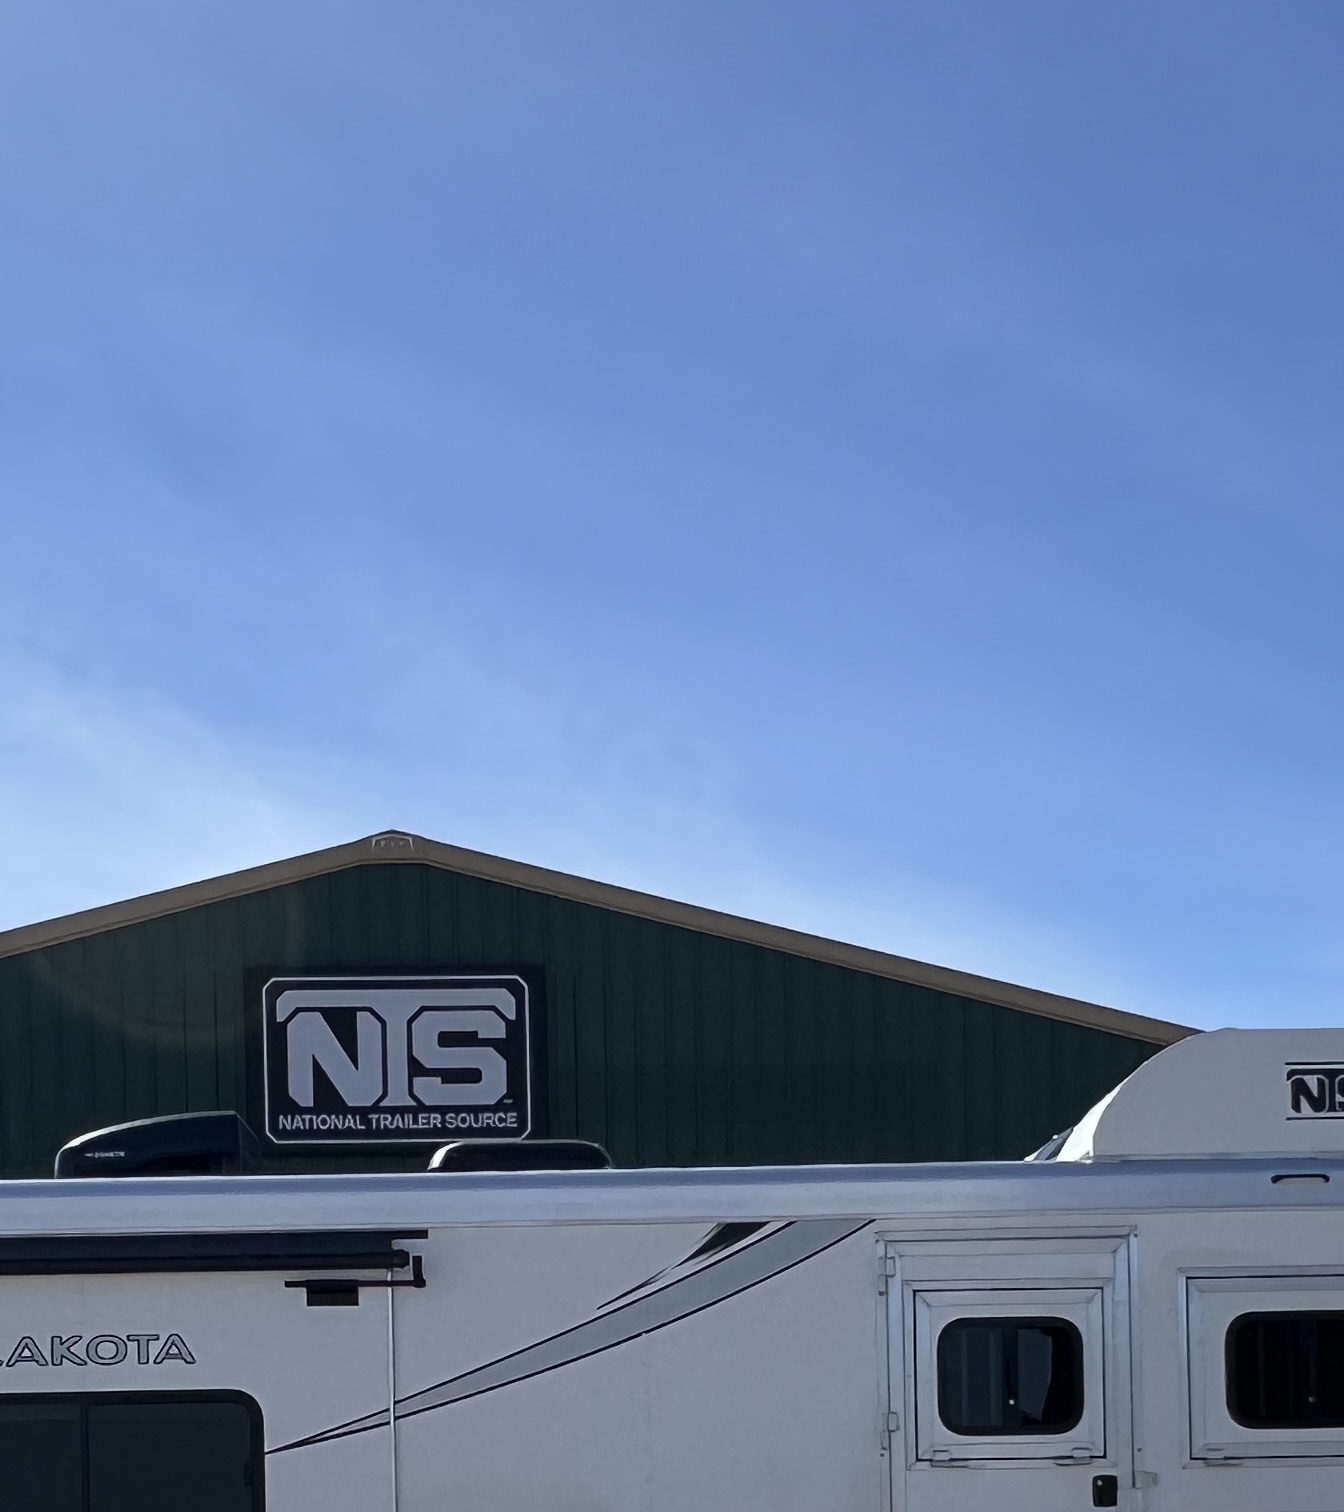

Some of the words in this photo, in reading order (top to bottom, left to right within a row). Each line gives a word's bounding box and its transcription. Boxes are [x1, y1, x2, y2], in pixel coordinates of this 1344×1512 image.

[276, 988, 516, 1107] NTS
[278, 1114, 366, 1131] NATIONAL
[368, 1113, 443, 1129] TRAILER
[445, 1112, 518, 1128] SOURCE
